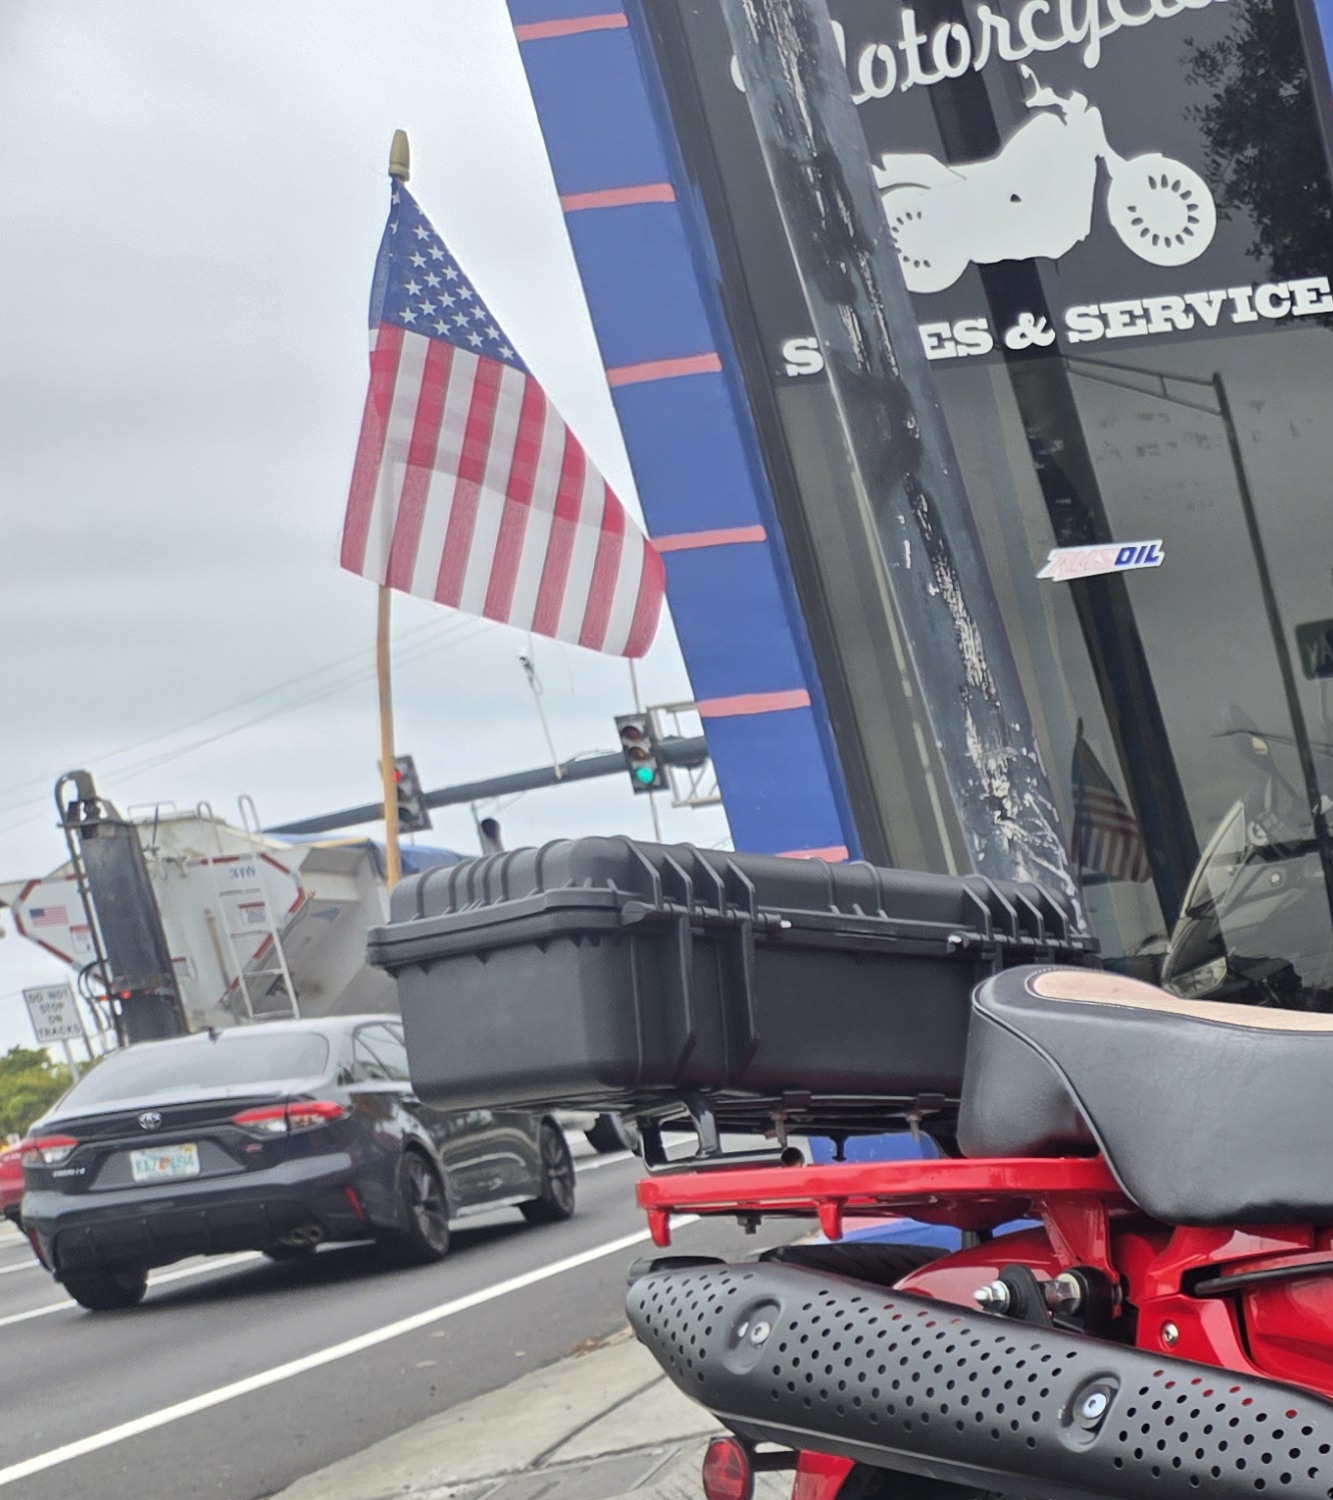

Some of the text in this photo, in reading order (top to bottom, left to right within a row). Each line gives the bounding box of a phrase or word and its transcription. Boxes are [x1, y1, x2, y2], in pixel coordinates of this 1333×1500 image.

[782, 318, 994, 378] SES
[1005, 312, 1056, 350] &
[1045, 543, 1160, 578] AMSOIL
